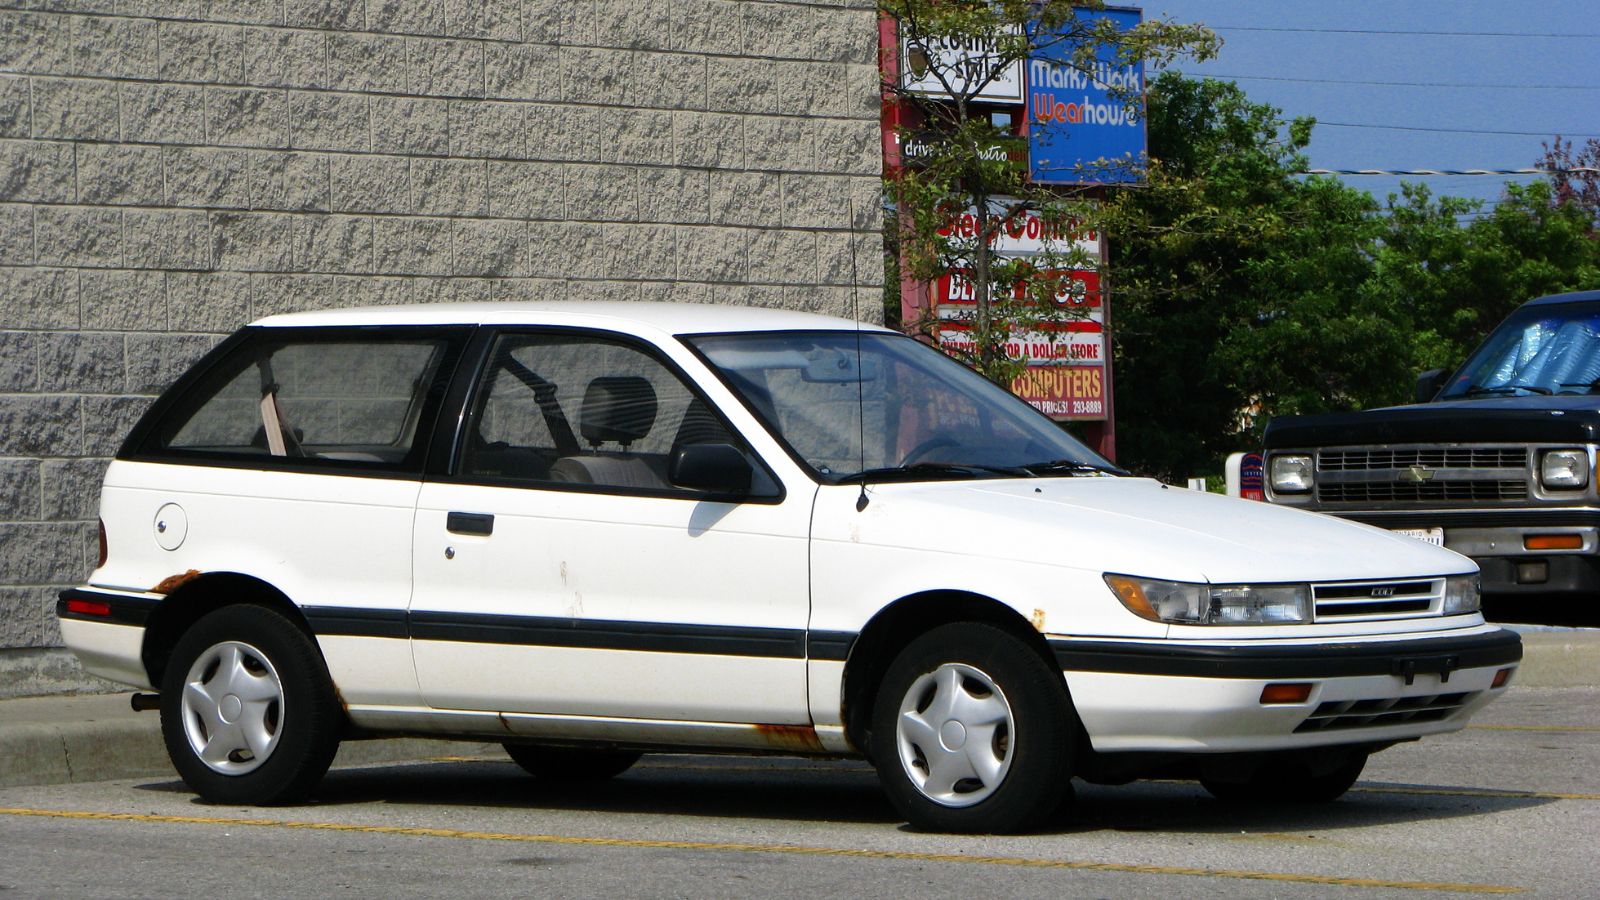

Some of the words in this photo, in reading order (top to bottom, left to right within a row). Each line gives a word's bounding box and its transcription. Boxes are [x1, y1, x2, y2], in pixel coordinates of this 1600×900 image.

[1092, 61, 1139, 92] Work
[1034, 93, 1137, 126] Wearhouse
[1024, 343, 1030, 358] A
[1070, 343, 1098, 359] STORE
[1012, 369, 1101, 399] COMPUTERS
